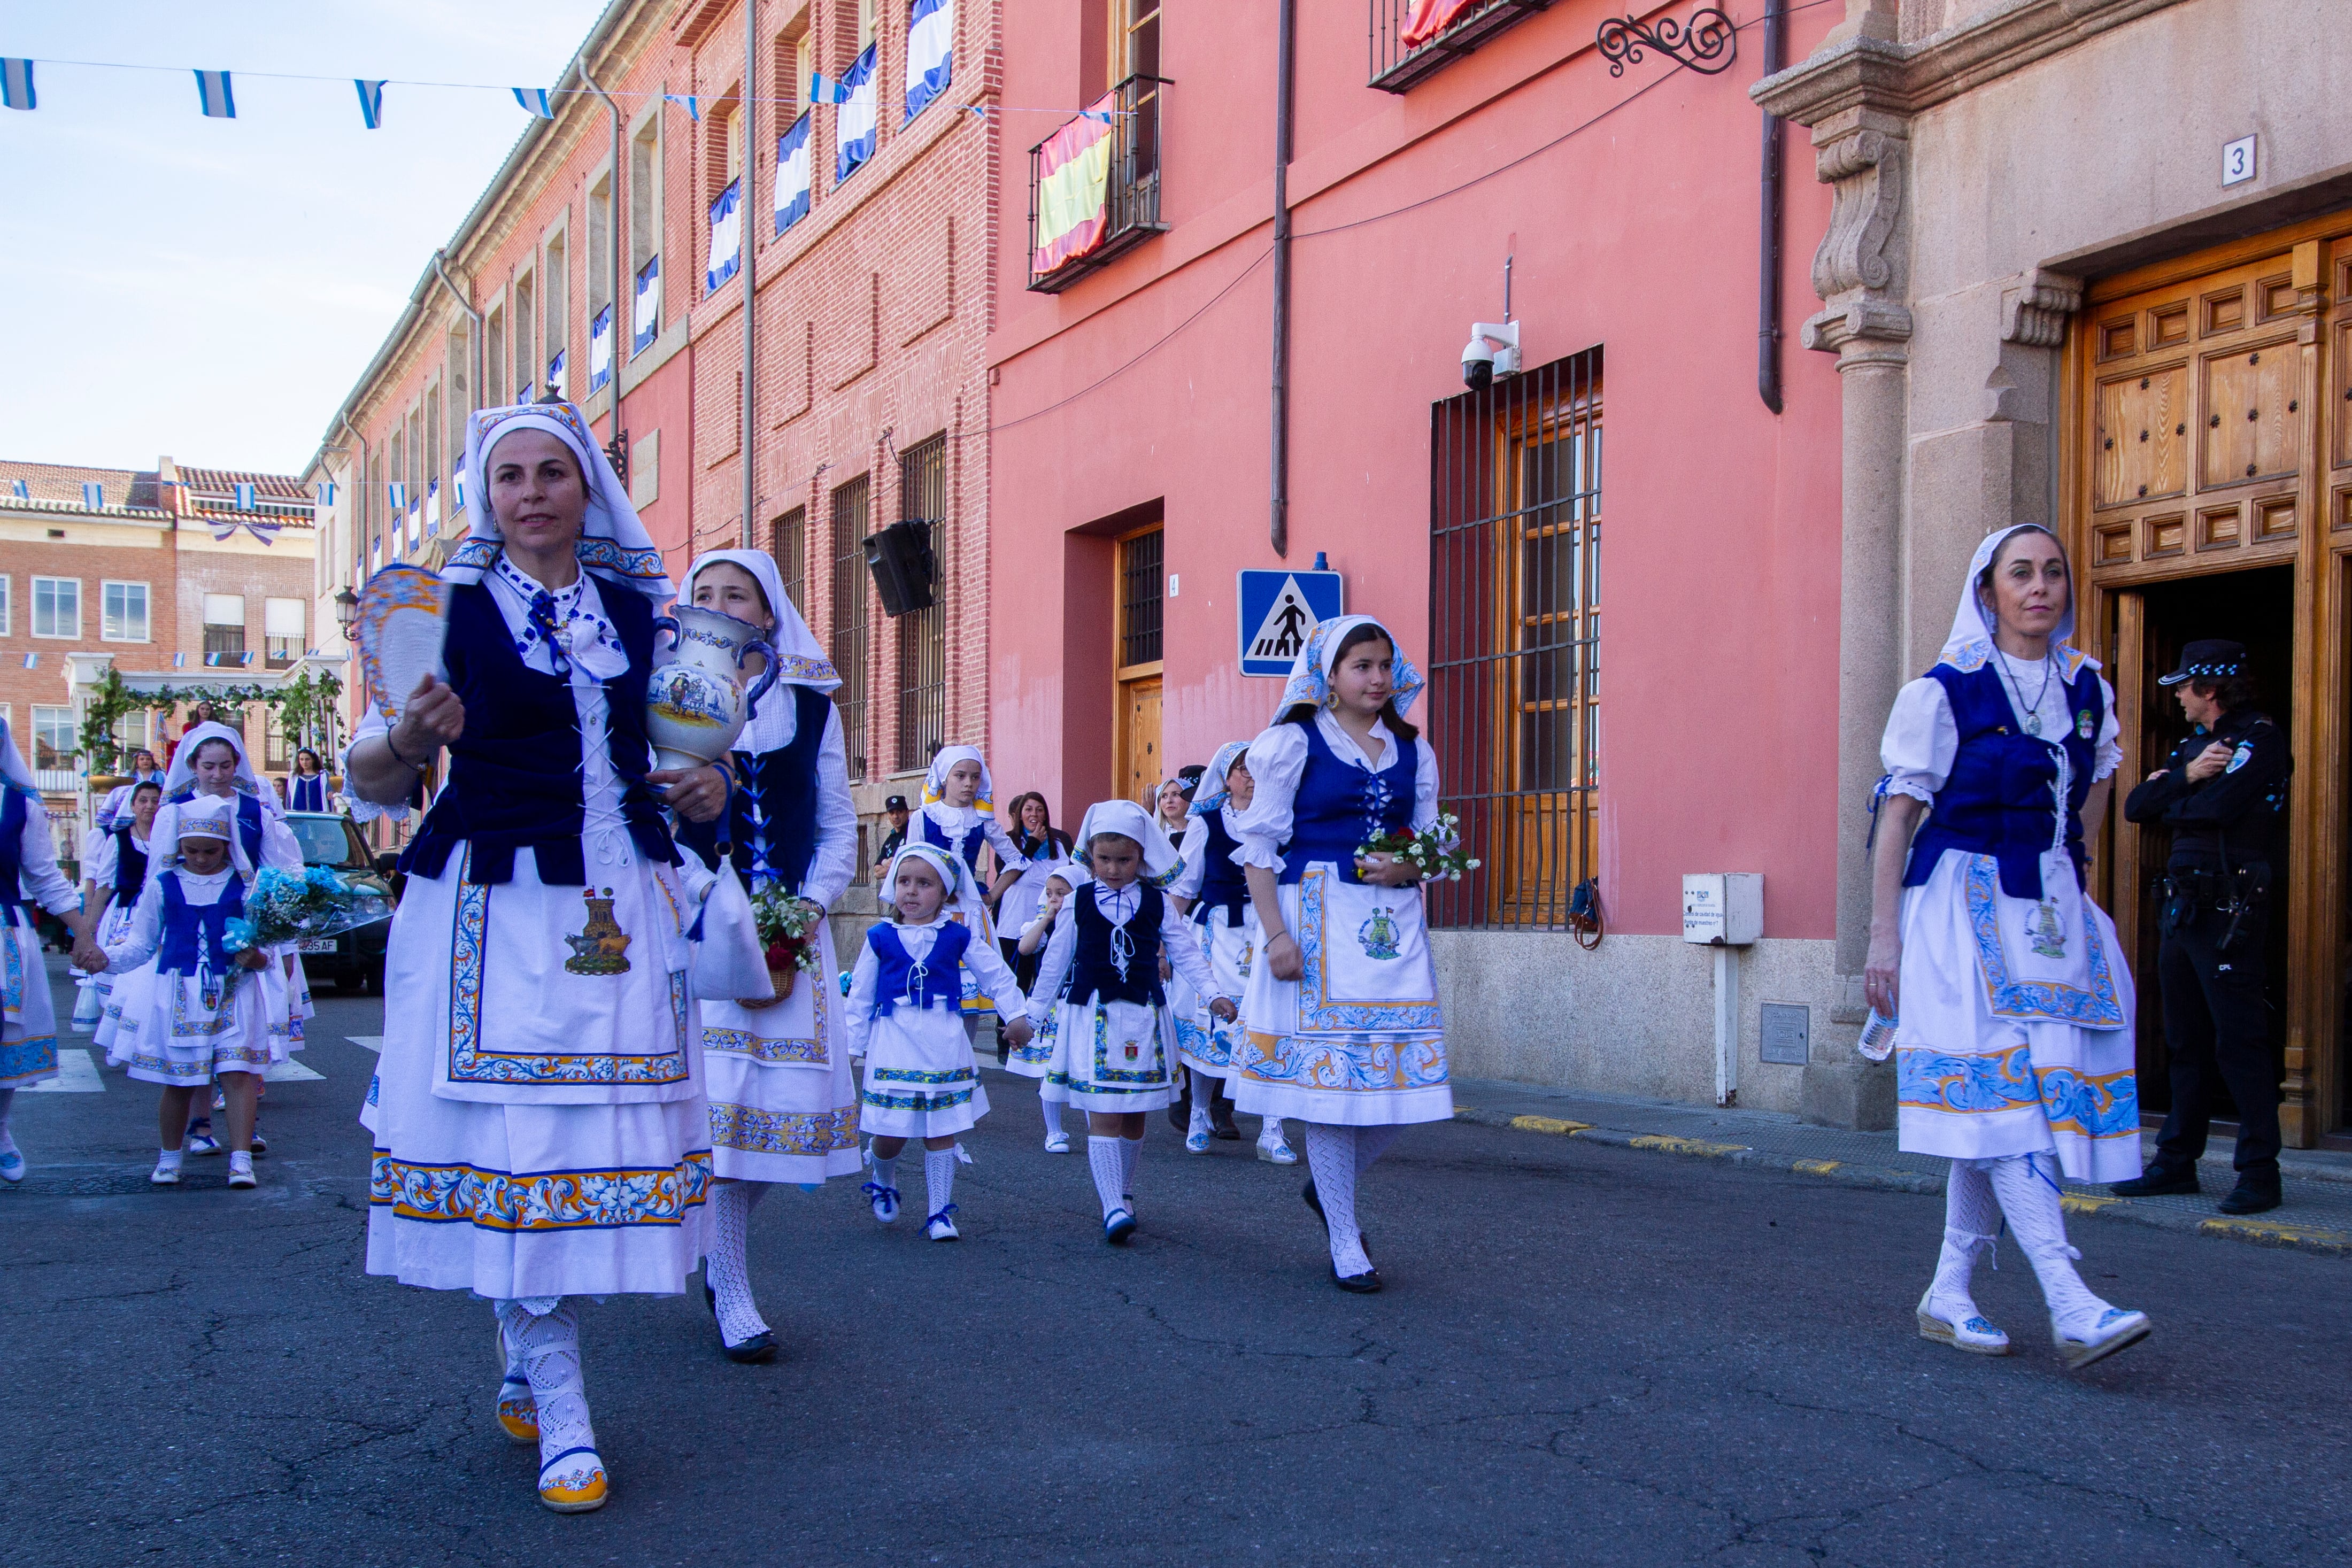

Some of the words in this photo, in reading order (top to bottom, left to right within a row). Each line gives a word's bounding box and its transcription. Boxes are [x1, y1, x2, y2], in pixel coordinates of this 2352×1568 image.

[2232, 147, 2244, 175] 3
[1171, 578, 1176, 593] 4
[322, 941, 334, 951] AF
